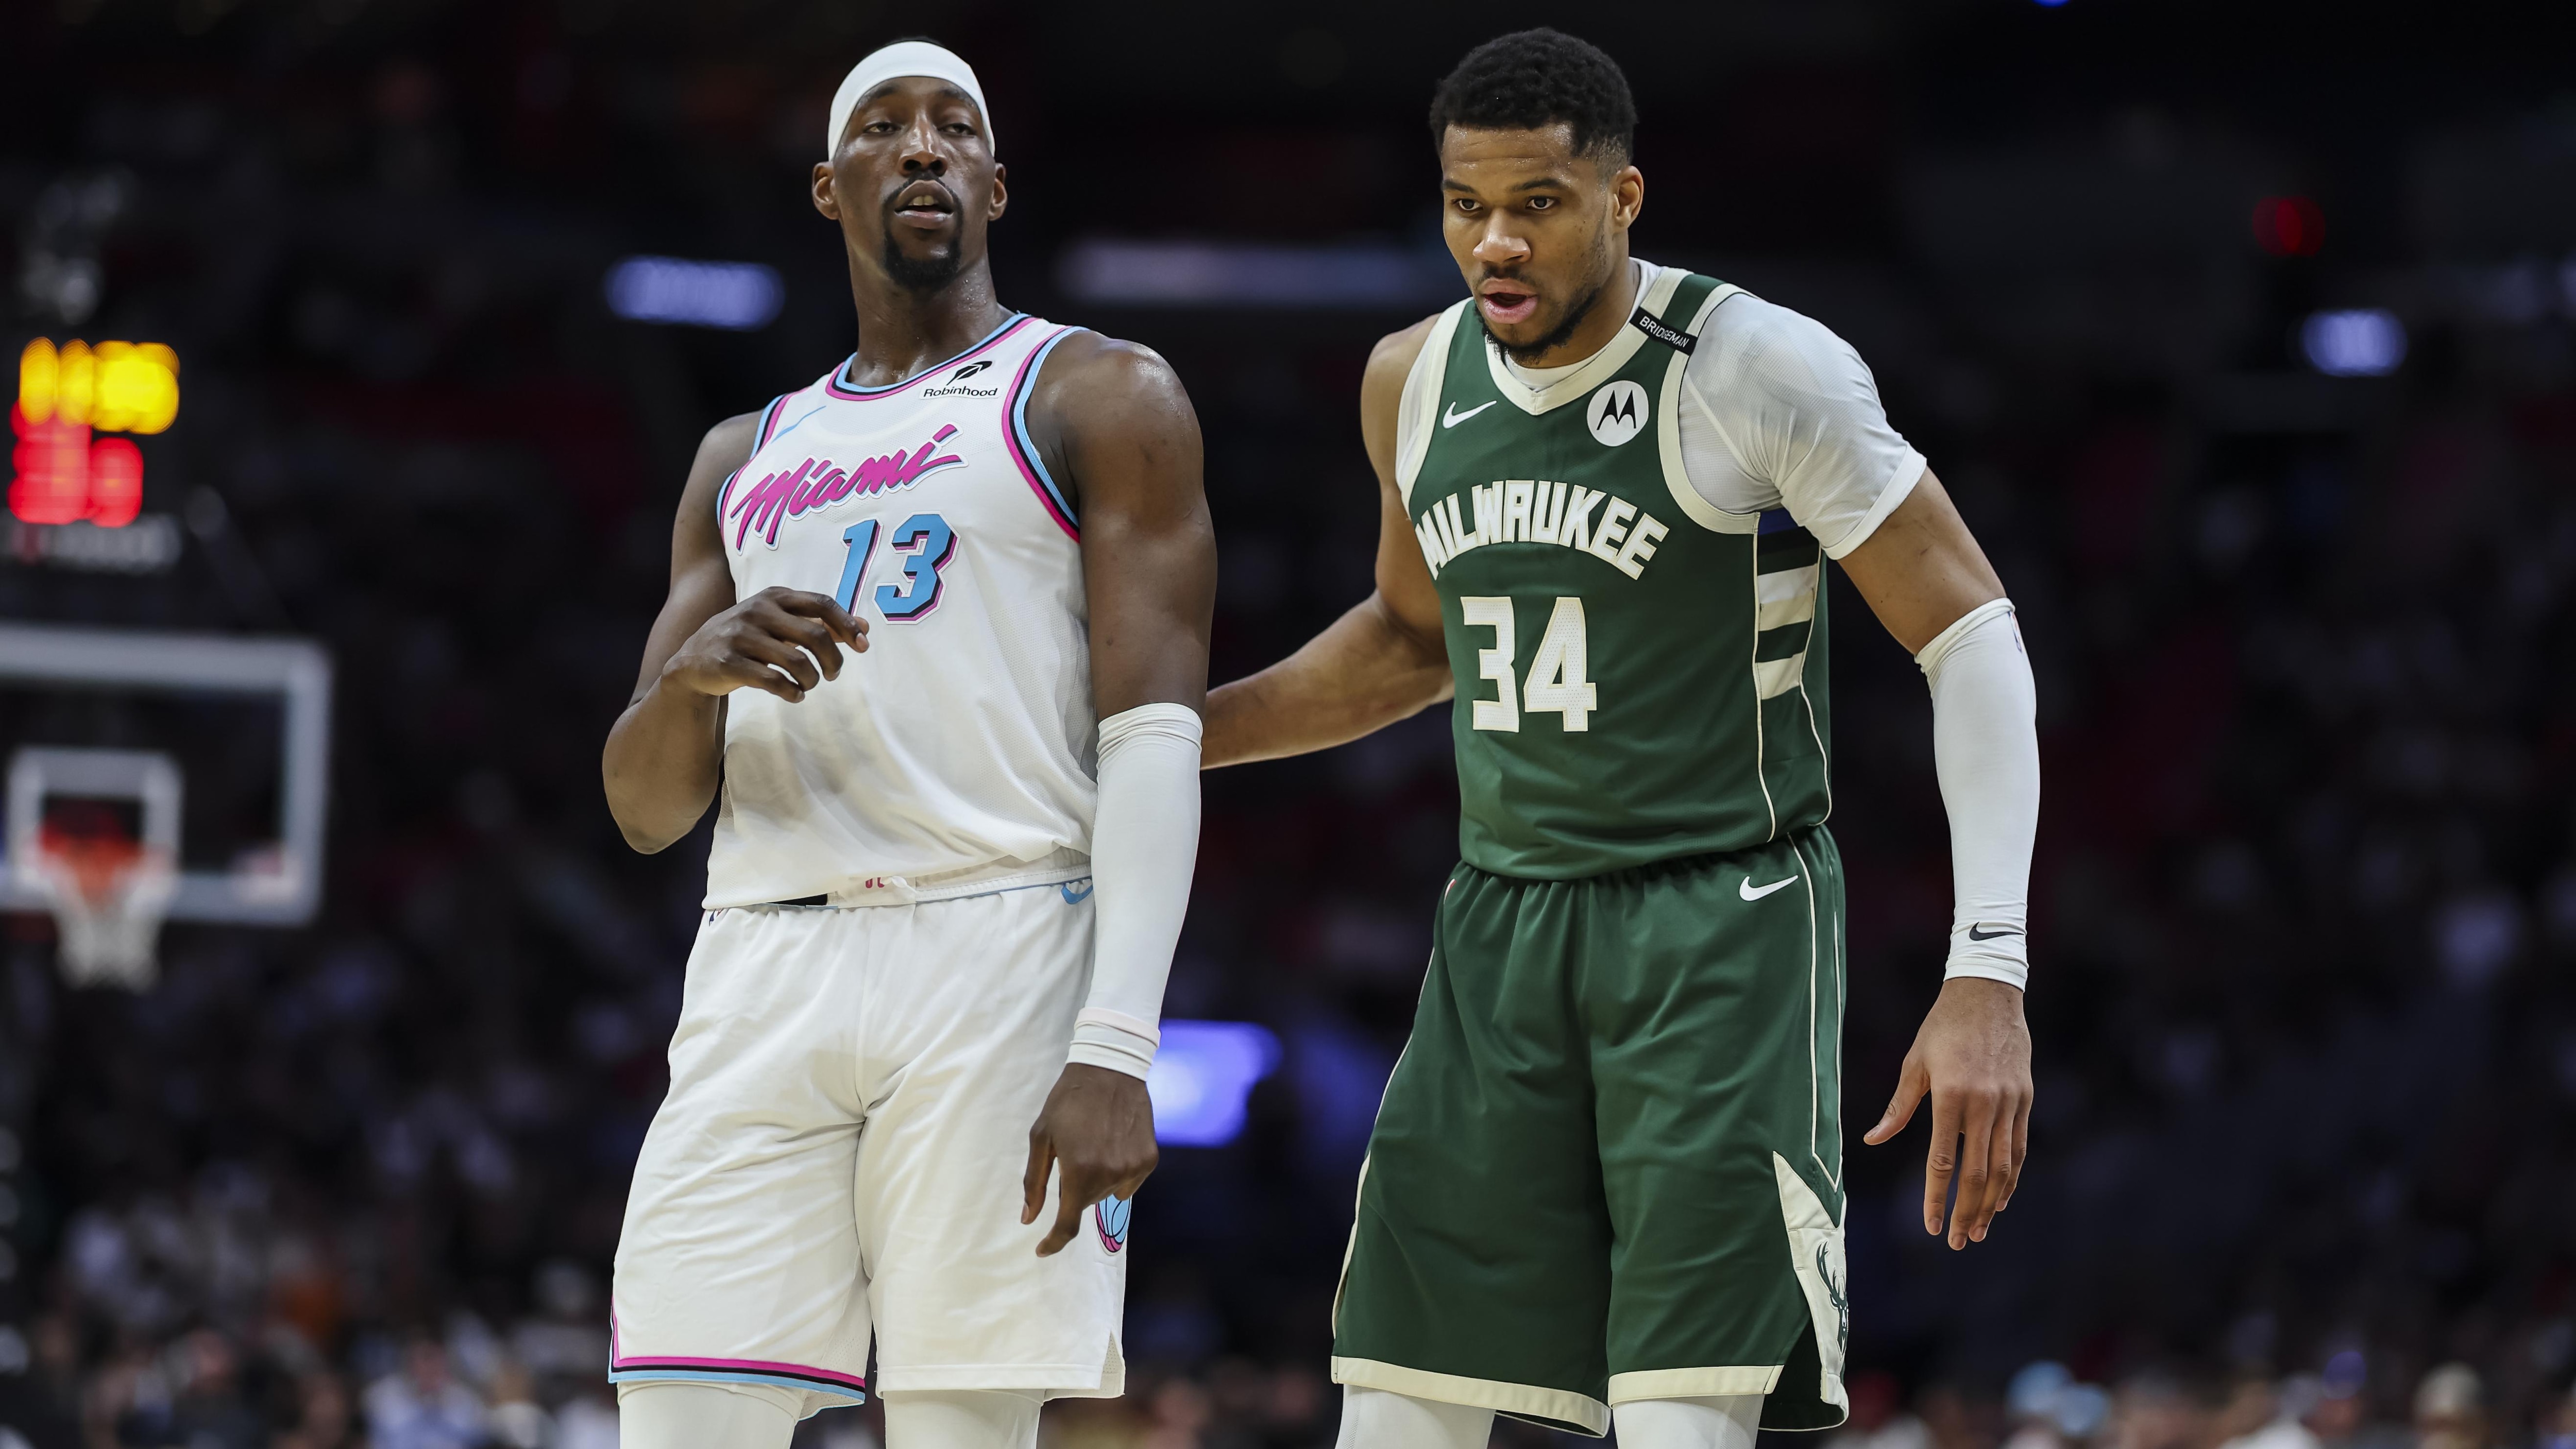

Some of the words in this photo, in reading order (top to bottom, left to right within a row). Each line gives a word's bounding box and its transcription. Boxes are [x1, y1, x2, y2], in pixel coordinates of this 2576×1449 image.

[924, 386, 998, 397] Robinhood
[730, 423, 964, 551] Miami
[1415, 480, 1670, 581] MILWAUKEE
[834, 512, 959, 624] 13
[1460, 596, 1597, 733] 34
